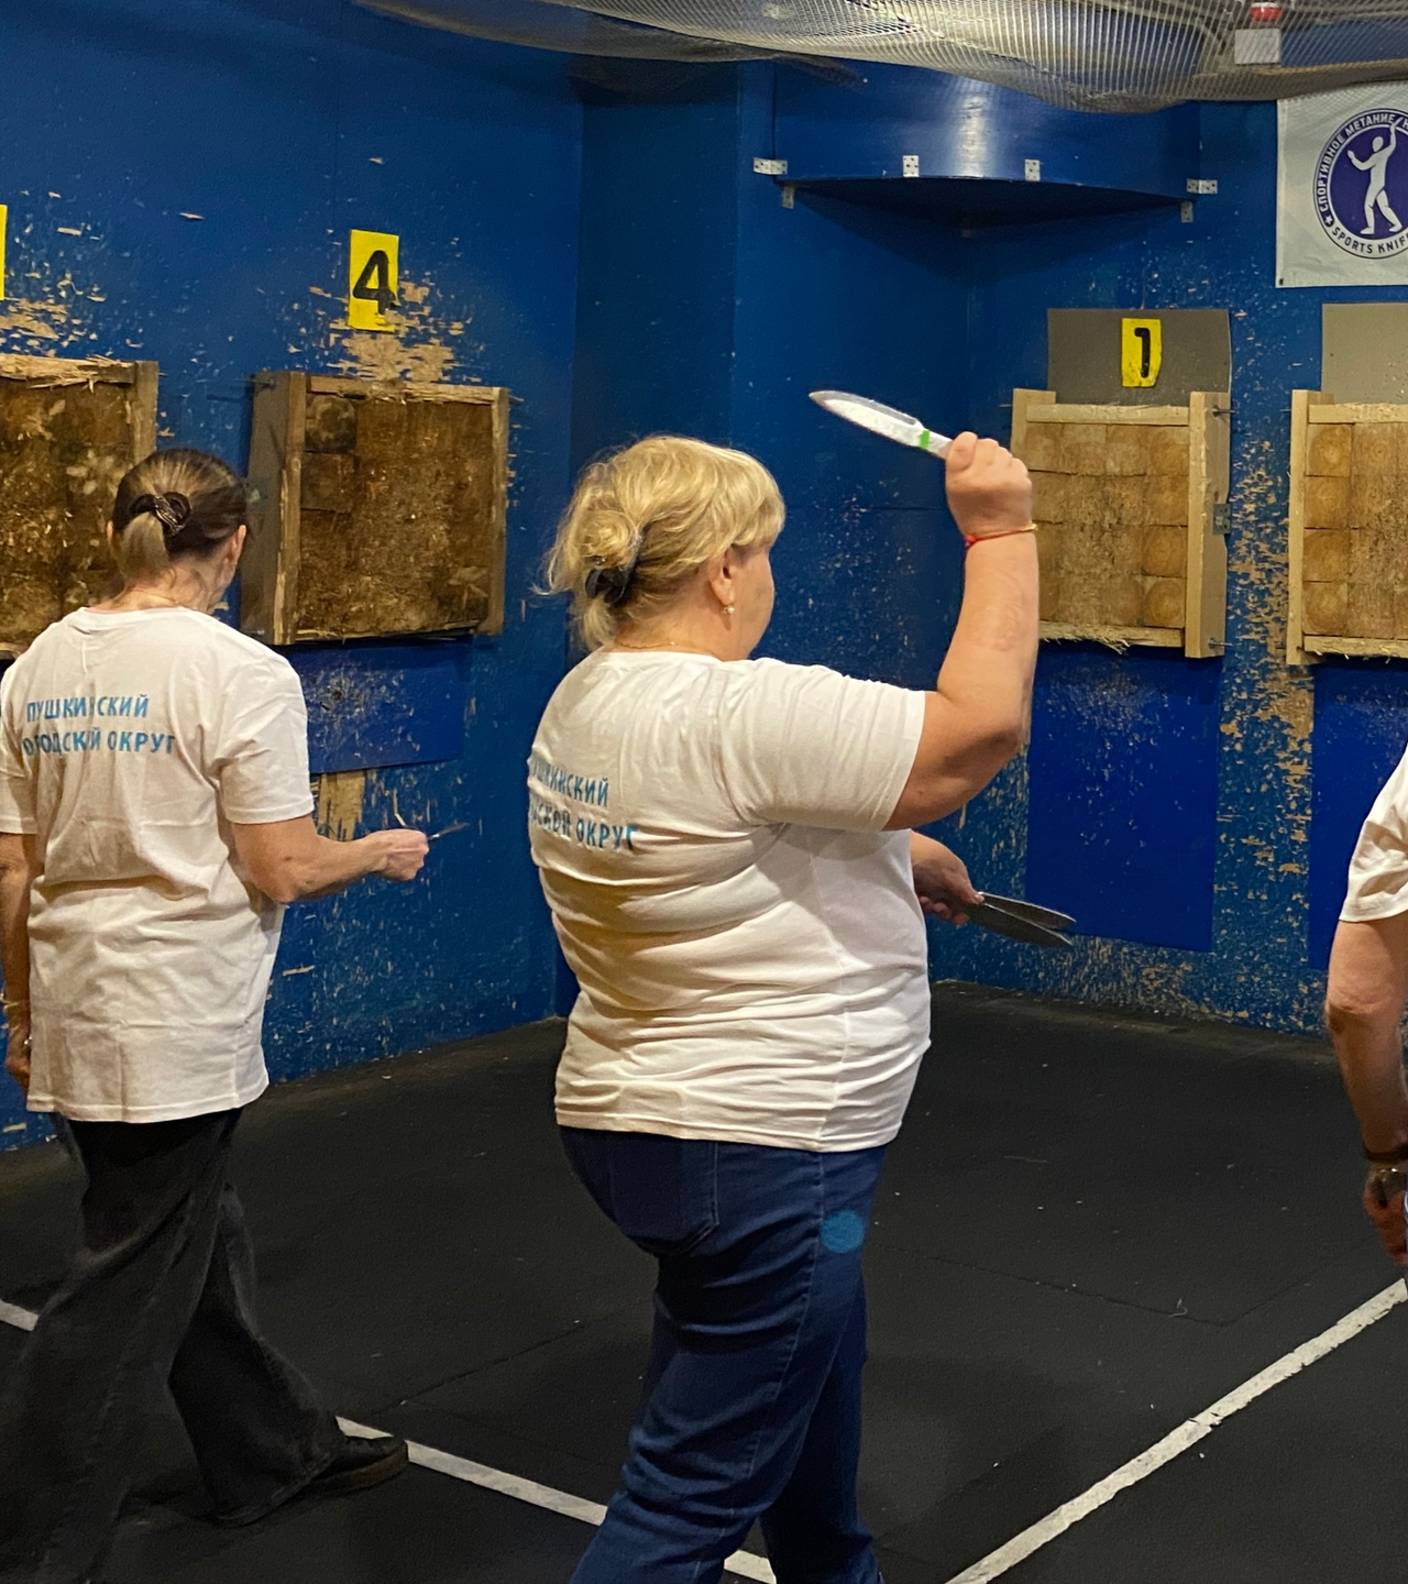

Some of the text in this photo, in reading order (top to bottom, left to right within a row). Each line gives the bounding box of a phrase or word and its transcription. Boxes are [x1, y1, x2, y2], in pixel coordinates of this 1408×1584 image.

[1316, 133, 1346, 214] СПОРТИВНОЕ
[1345, 113, 1396, 136] МЕТАНИЕ
[1332, 227, 1374, 254] SPORTS
[352, 250, 396, 315] 4
[1134, 327, 1151, 379] 1
[27, 694, 149, 722] ПУШКИСКИЙ
[107, 731, 175, 754] ОКРУГ
[575, 818, 638, 851] ОКРУГ
